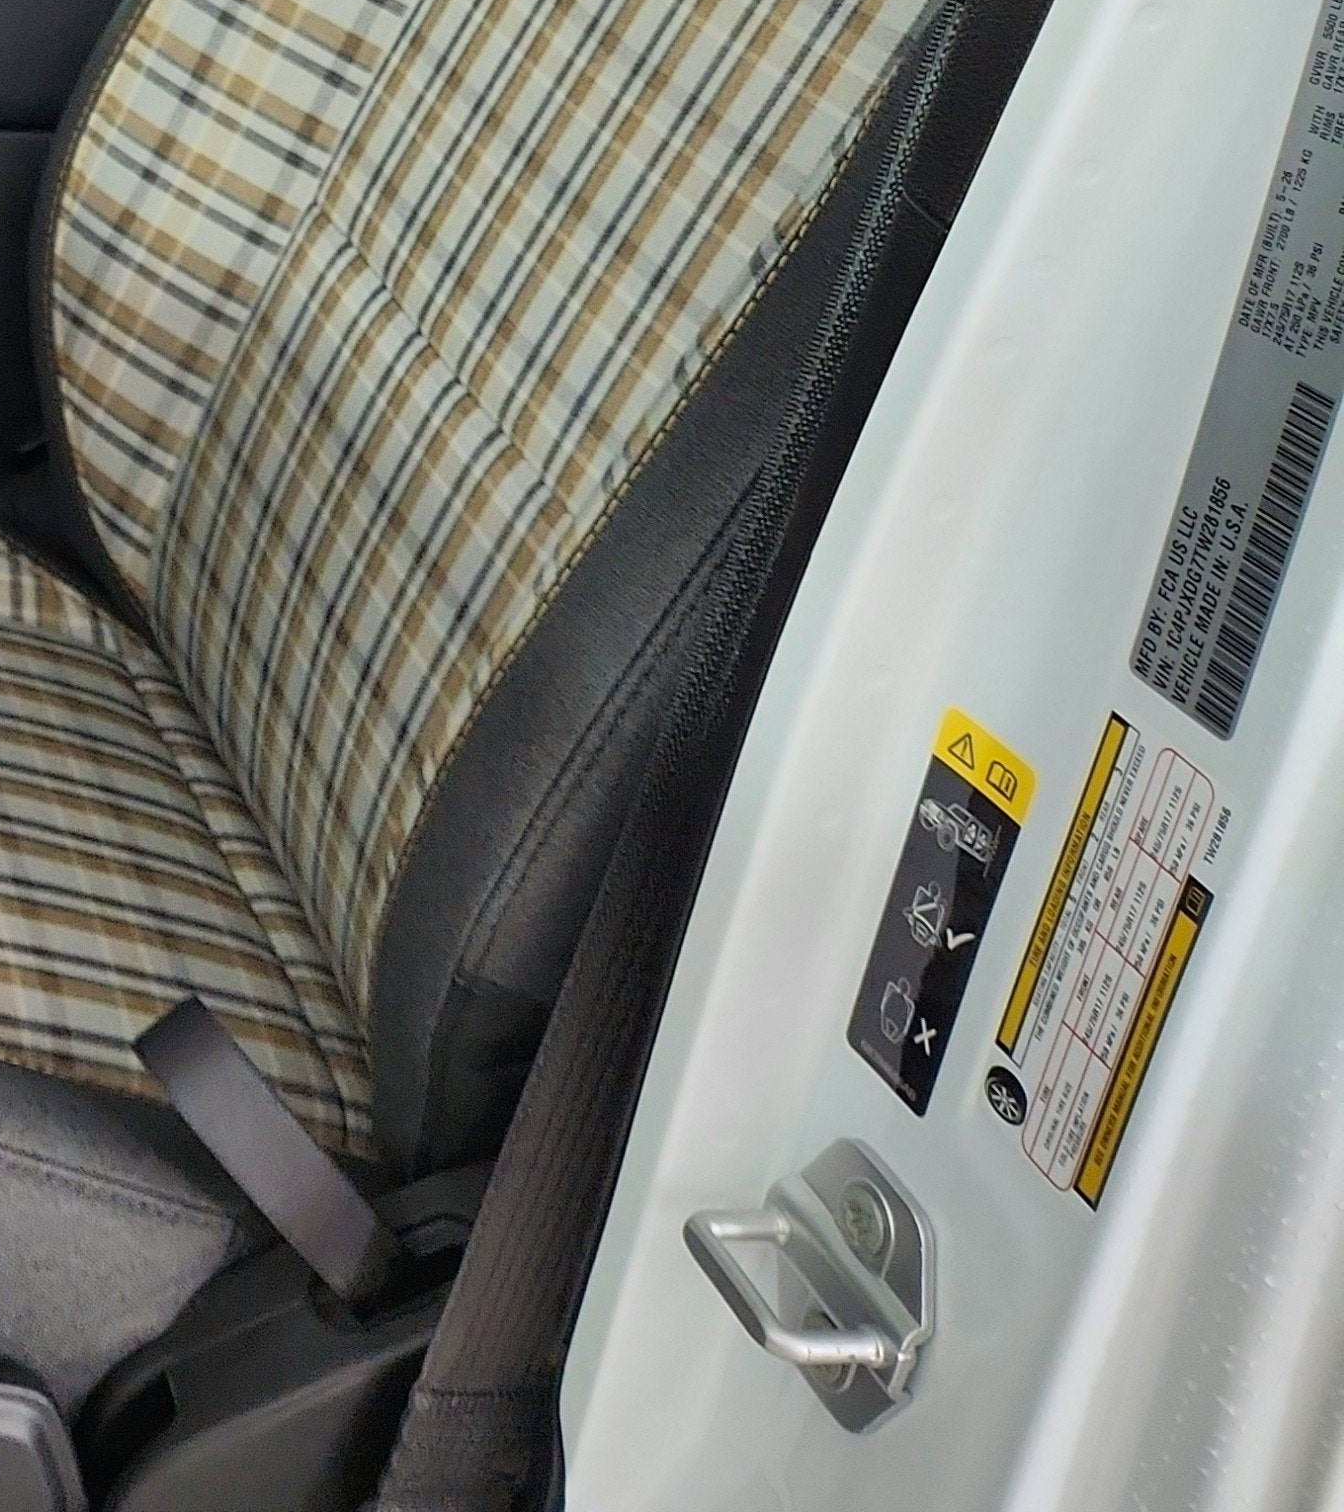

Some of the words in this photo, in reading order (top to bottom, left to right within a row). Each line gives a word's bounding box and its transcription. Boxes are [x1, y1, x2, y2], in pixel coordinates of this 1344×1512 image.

[1307, 48, 1329, 86] GVWR:
[1321, 12, 1338, 42] 5500
[1321, 53, 1340, 91] GAWR
[1307, 102, 1325, 136] WITH
[1318, 110, 1336, 141] RIMS
[1250, 297, 1269, 333] GAWR
[1275, 223, 1291, 250] 2700
[1292, 166, 1307, 193] 1225
[1300, 147, 1312, 165] KG
[1252, 252, 1268, 279] MFR
[1247, 279, 1260, 296] OF
[1283, 336, 1295, 352] AT
[1295, 290, 1309, 312] kPa
[1310, 241, 1324, 262] PSI
[1320, 278, 1344, 324] VEHICLE
[1237, 296, 1255, 327] DATE
[1306, 297, 1322, 323] MPV
[1312, 325, 1329, 352] THIS
[1176, 504, 1198, 540] LLC
[1219, 500, 1249, 553] U.S.A.
[1168, 538, 1188, 567] US
[1209, 554, 1230, 581] IN:
[1152, 656, 1175, 691] VIN:
[1164, 476, 1231, 653] 1C4PJXDG7TW281856
[1157, 566, 1179, 603] FCA
[1146, 607, 1167, 637] BY:
[1193, 580, 1221, 634] MADE
[1134, 635, 1157, 678] MFD
[1171, 633, 1205, 706] VEHICLE
[1028, 944, 1042, 968] TIRE
[1037, 921, 1050, 943] AND
[1045, 878, 1065, 922] LOADING
[1060, 810, 1090, 880] INFORMATION
